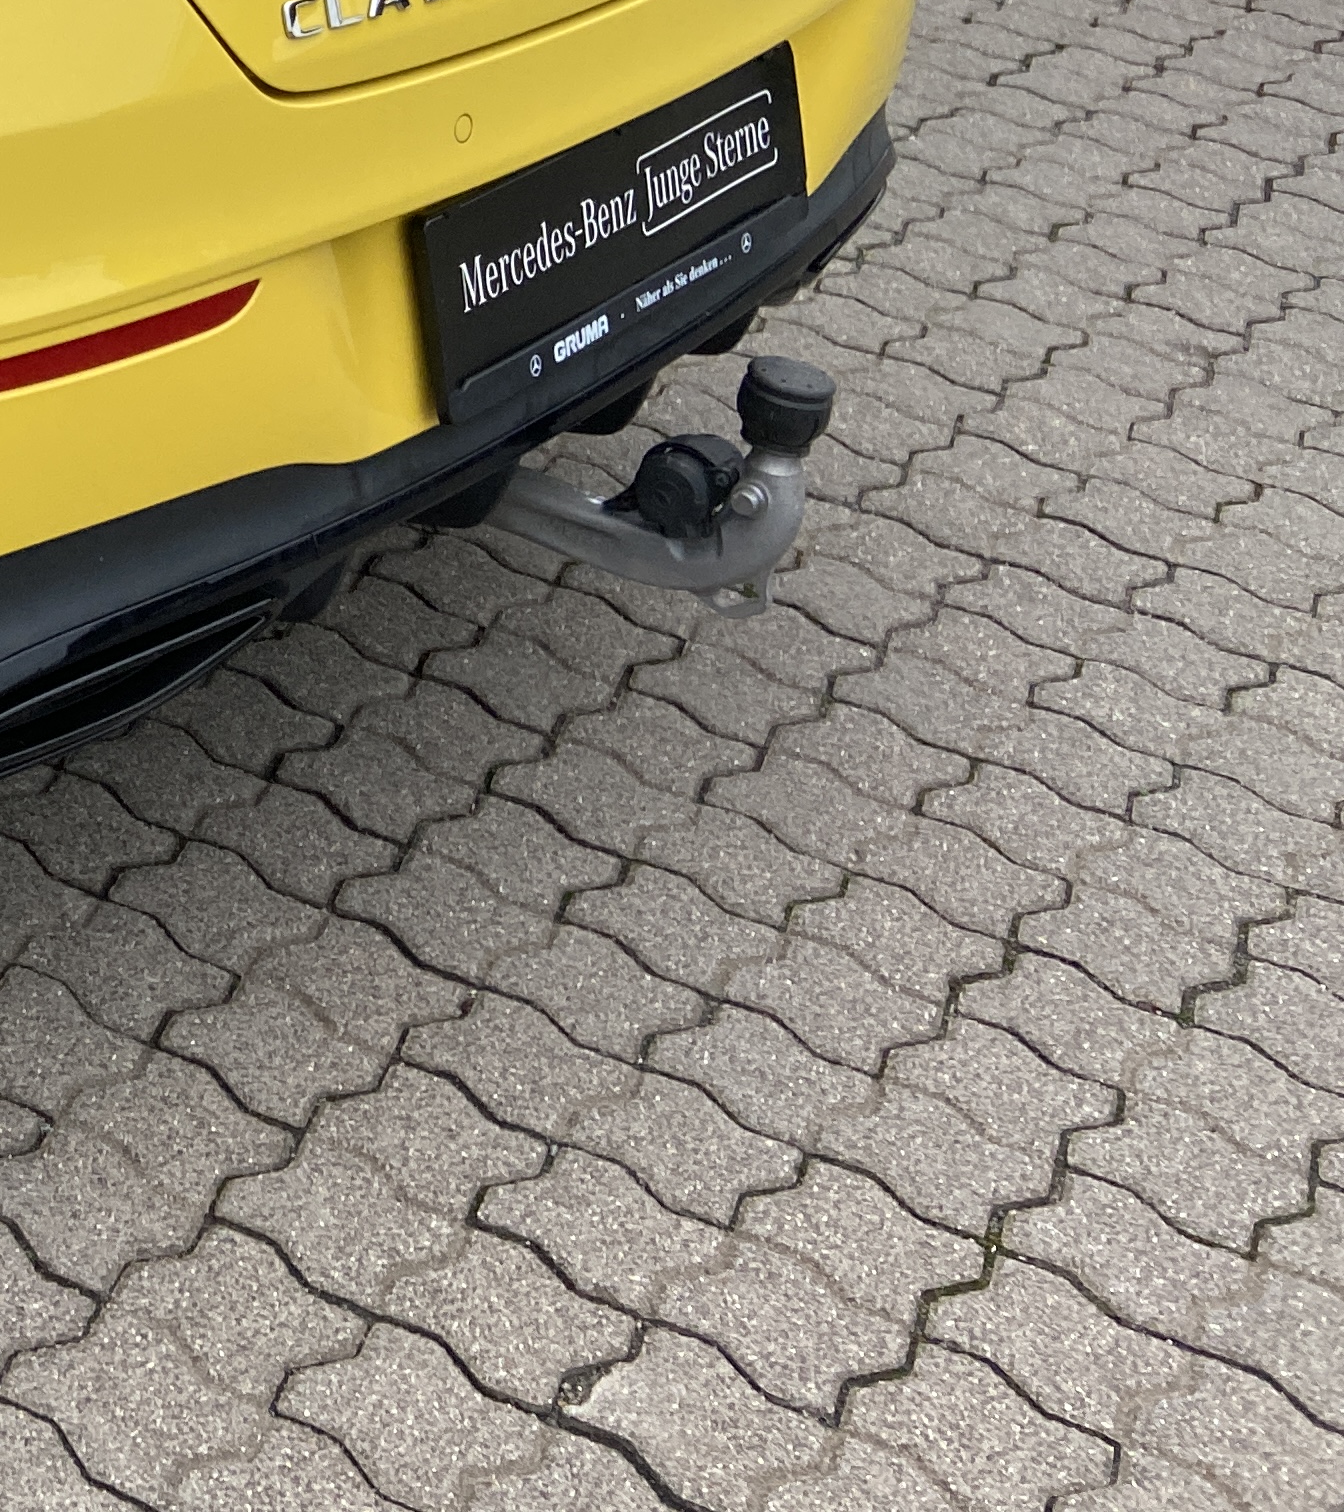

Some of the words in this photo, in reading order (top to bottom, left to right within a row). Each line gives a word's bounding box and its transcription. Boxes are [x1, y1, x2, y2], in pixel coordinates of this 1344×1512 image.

[458, 187, 638, 313] Mercedes-Benz
[642, 152, 703, 224] Junge
[703, 115, 771, 180] Sterne
[553, 313, 610, 364] GRUMA
[635, 288, 662, 313] Näher
[662, 279, 675, 297] als
[674, 271, 689, 291] Sie
